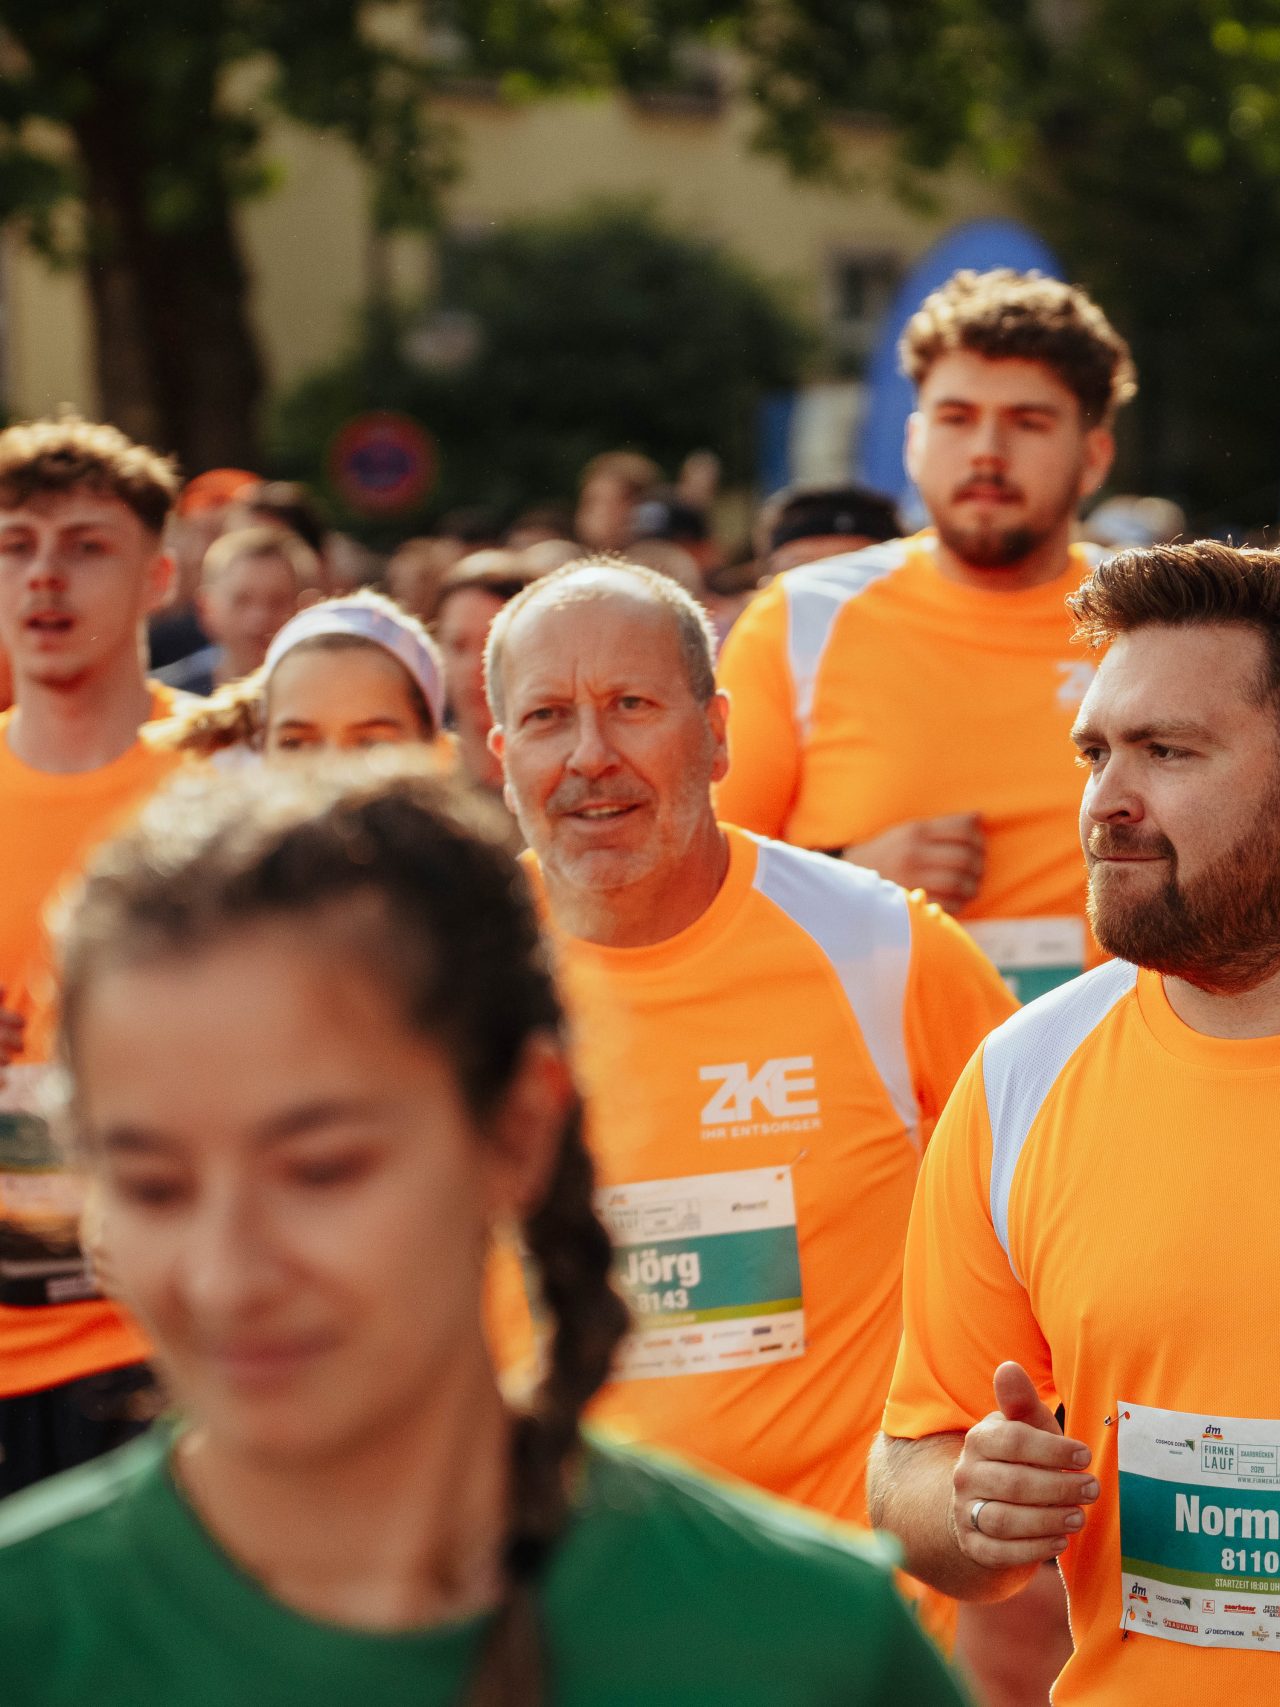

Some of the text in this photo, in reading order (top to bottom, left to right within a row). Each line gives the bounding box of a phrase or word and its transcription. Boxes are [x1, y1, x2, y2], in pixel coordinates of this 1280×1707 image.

[698, 1056, 819, 1125] ZKE
[702, 1118, 822, 1140] IHR ENTSORGER
[621, 1249, 701, 1288] Jörg
[1204, 1444, 1235, 1456] FIRMEN
[1204, 1456, 1234, 1471] LAUF
[1221, 1548, 1279, 1574] 8110
[1131, 1582, 1147, 1597] dm
[1214, 1578, 1250, 1590] STARTZEIT
[1166, 1619, 1198, 1633] BAUHAUS
[1212, 1628, 1245, 1637] DECATHLON
